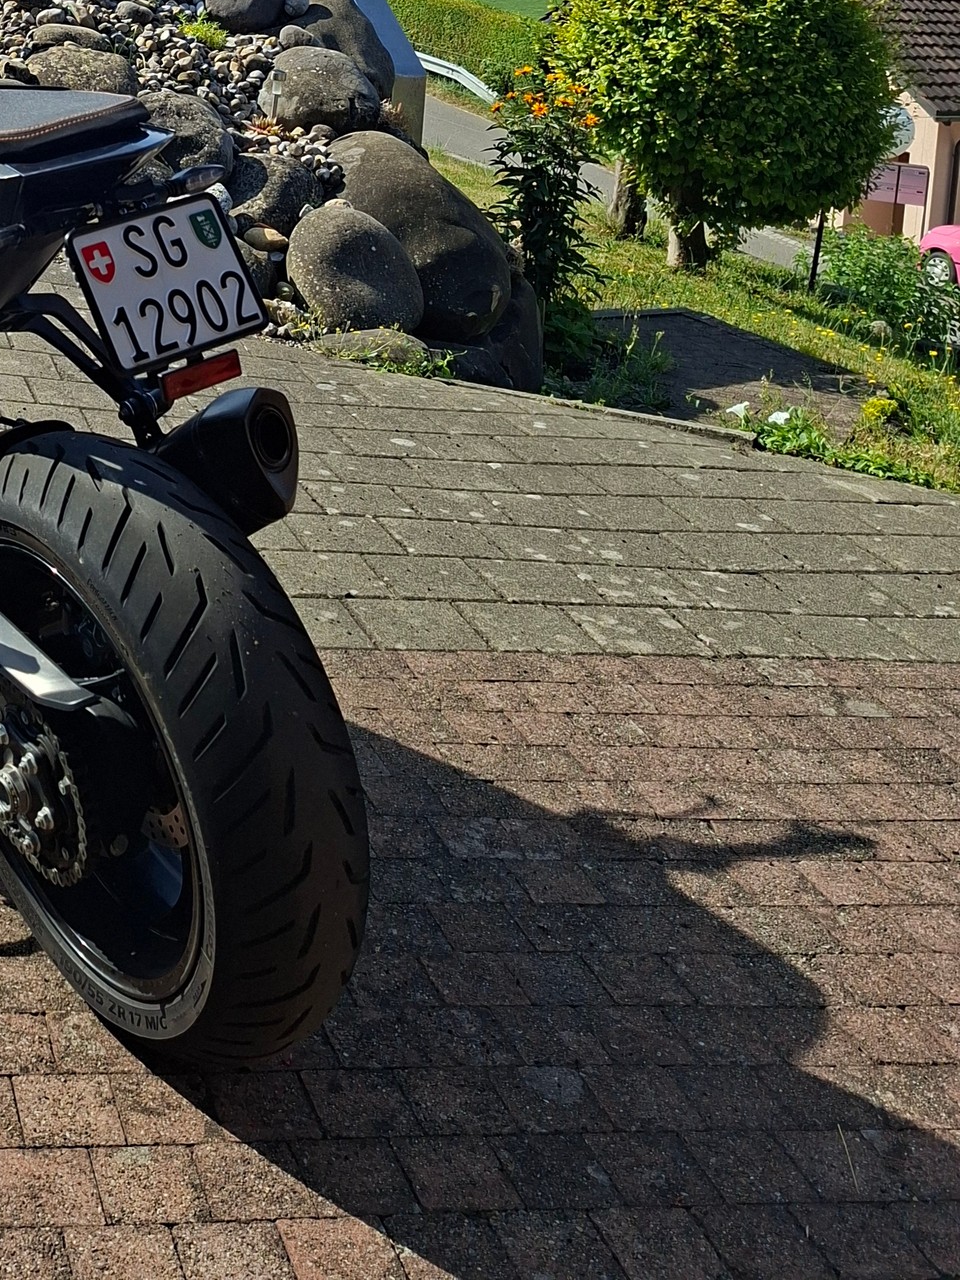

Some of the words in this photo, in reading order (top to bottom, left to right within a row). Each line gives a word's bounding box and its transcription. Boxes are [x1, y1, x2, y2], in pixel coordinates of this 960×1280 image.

[122, 215, 189, 278] SG
[112, 270, 261, 363] 12902
[57, 953, 105, 1007] 190/55
[144, 1015, 168, 1031] M/C
